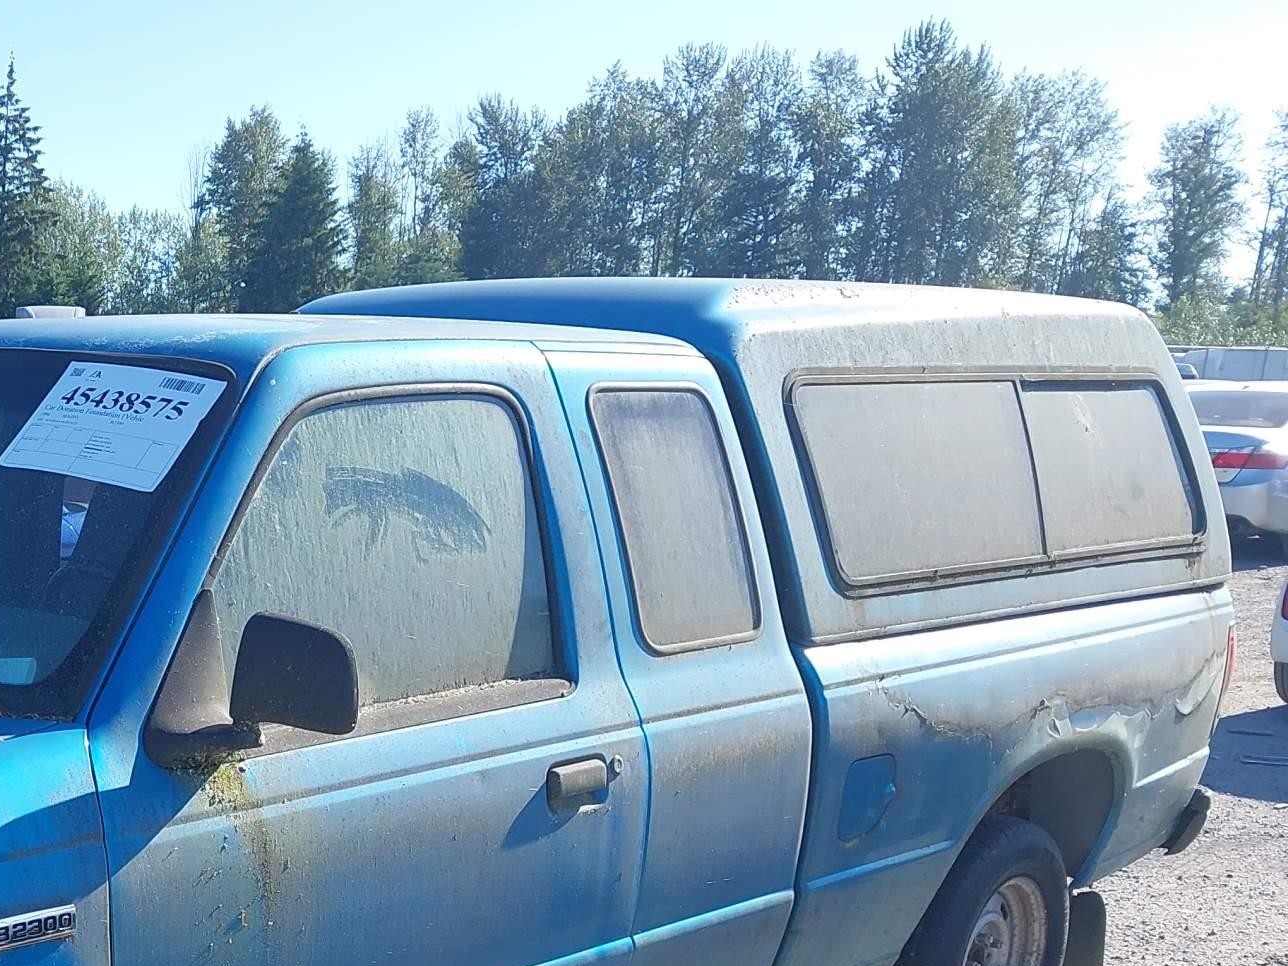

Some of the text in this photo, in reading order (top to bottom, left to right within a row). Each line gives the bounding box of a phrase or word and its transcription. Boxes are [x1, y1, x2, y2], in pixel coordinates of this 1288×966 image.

[56, 405, 85, 414] Donation
[85, 409, 121, 418] Foundation
[62, 386, 190, 420] 45438575
